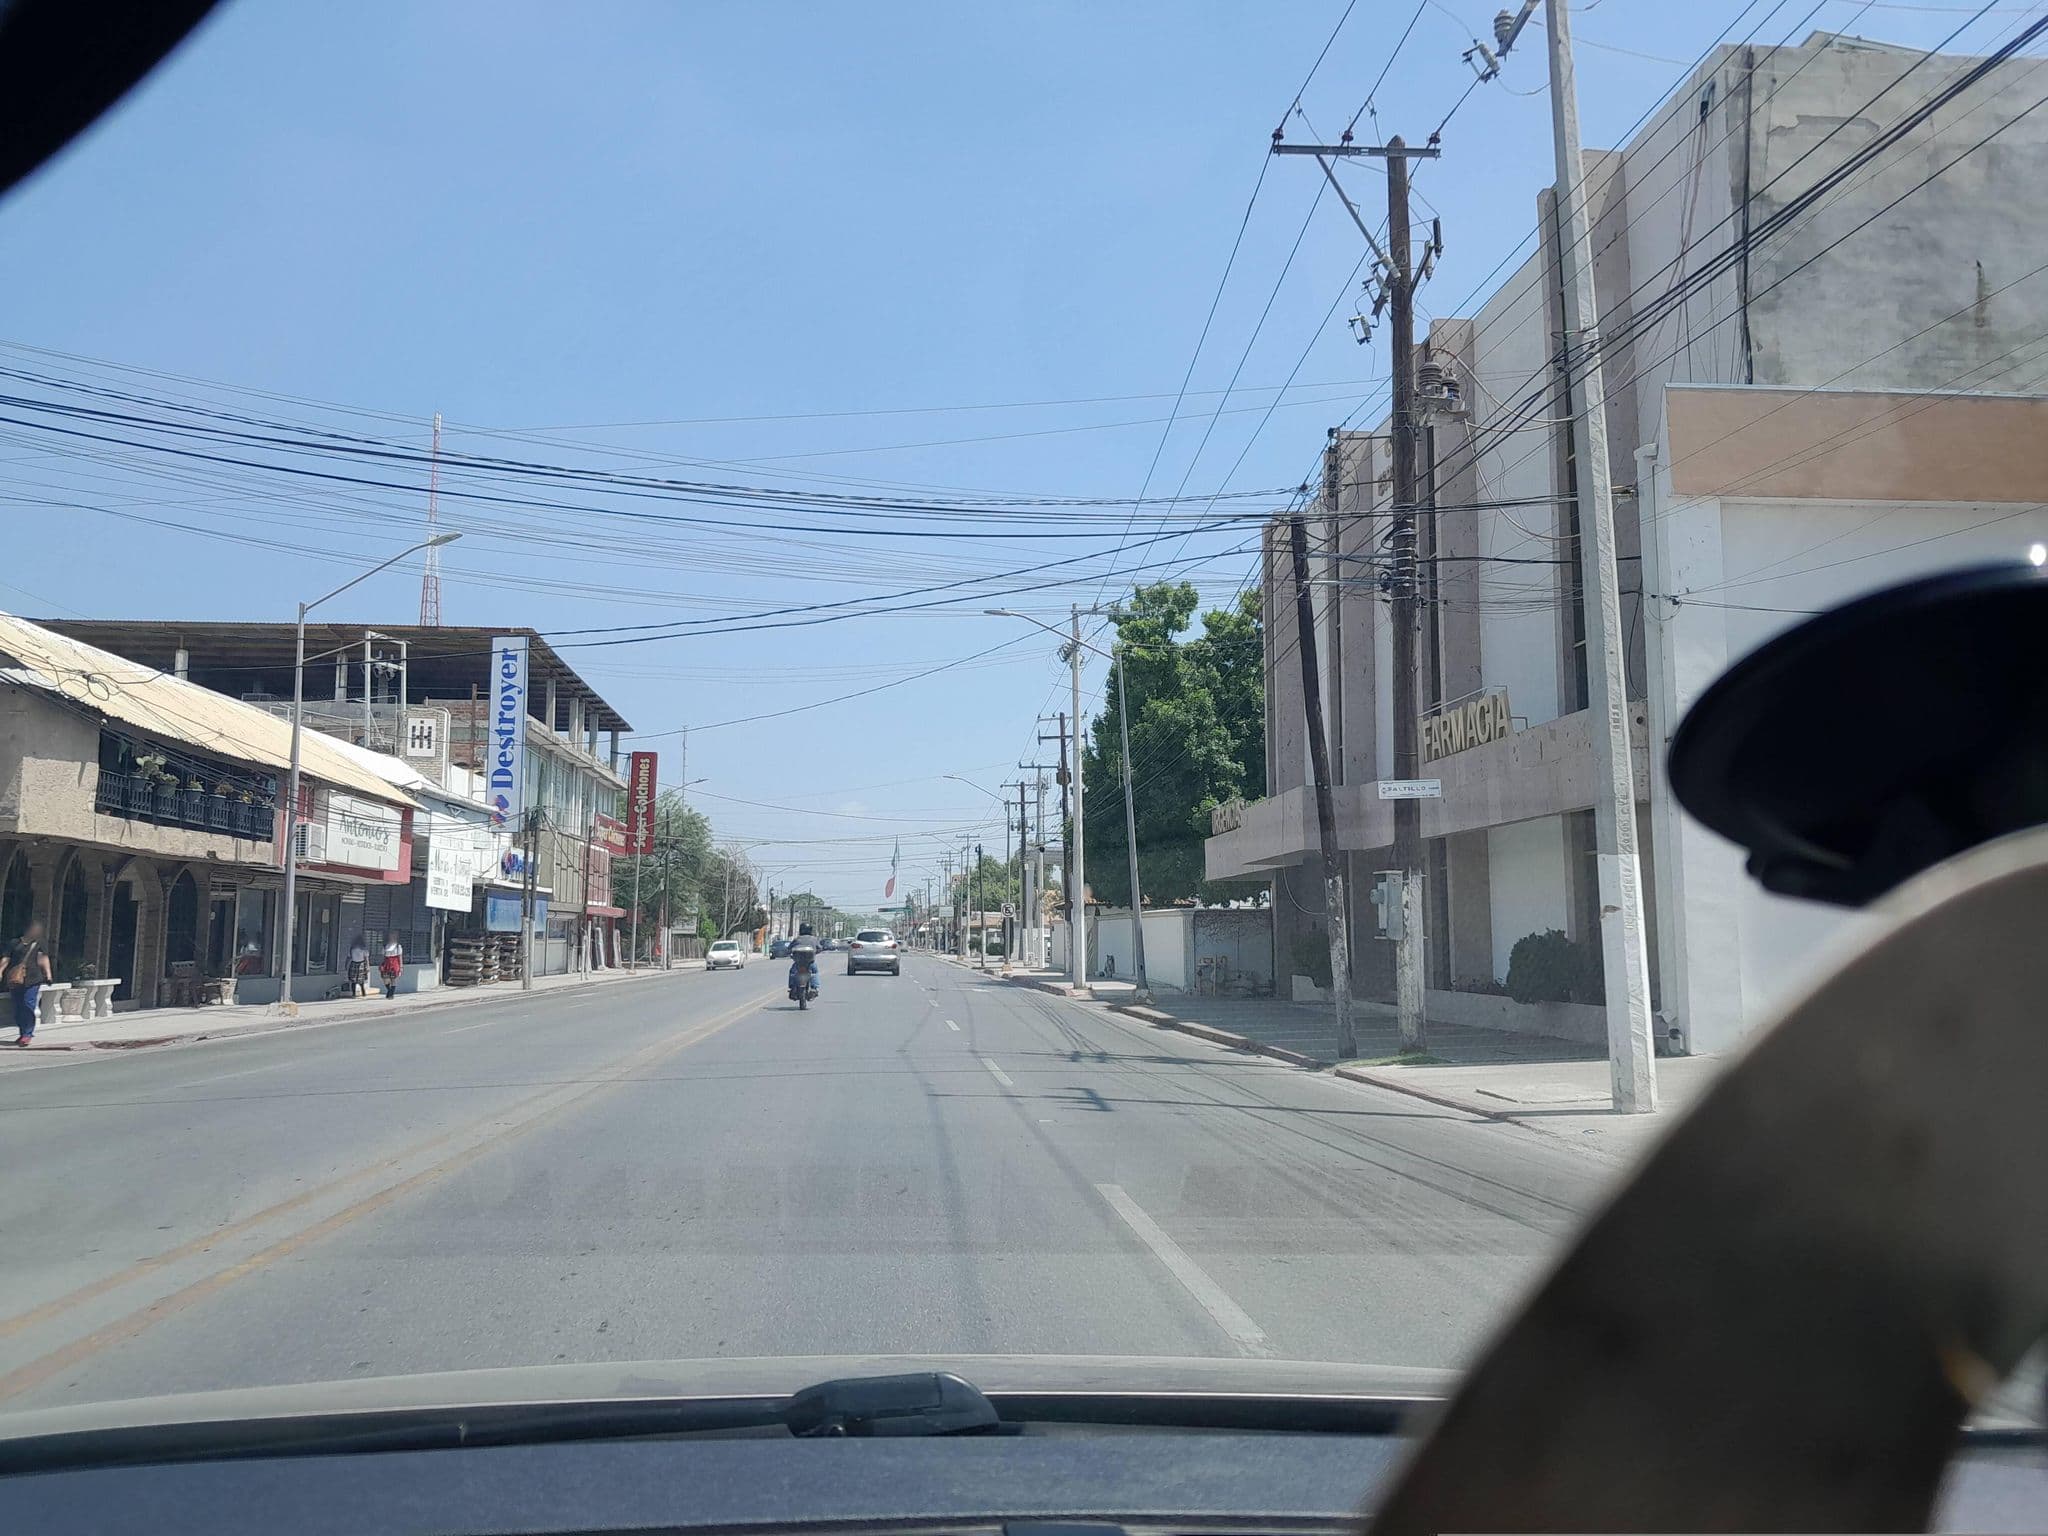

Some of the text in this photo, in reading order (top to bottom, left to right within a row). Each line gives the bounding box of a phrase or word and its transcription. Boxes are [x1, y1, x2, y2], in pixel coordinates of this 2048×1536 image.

[491, 647, 523, 790] Destroyer
[1422, 692, 1508, 762] FARMACIA
[633, 757, 651, 814] Colchones
